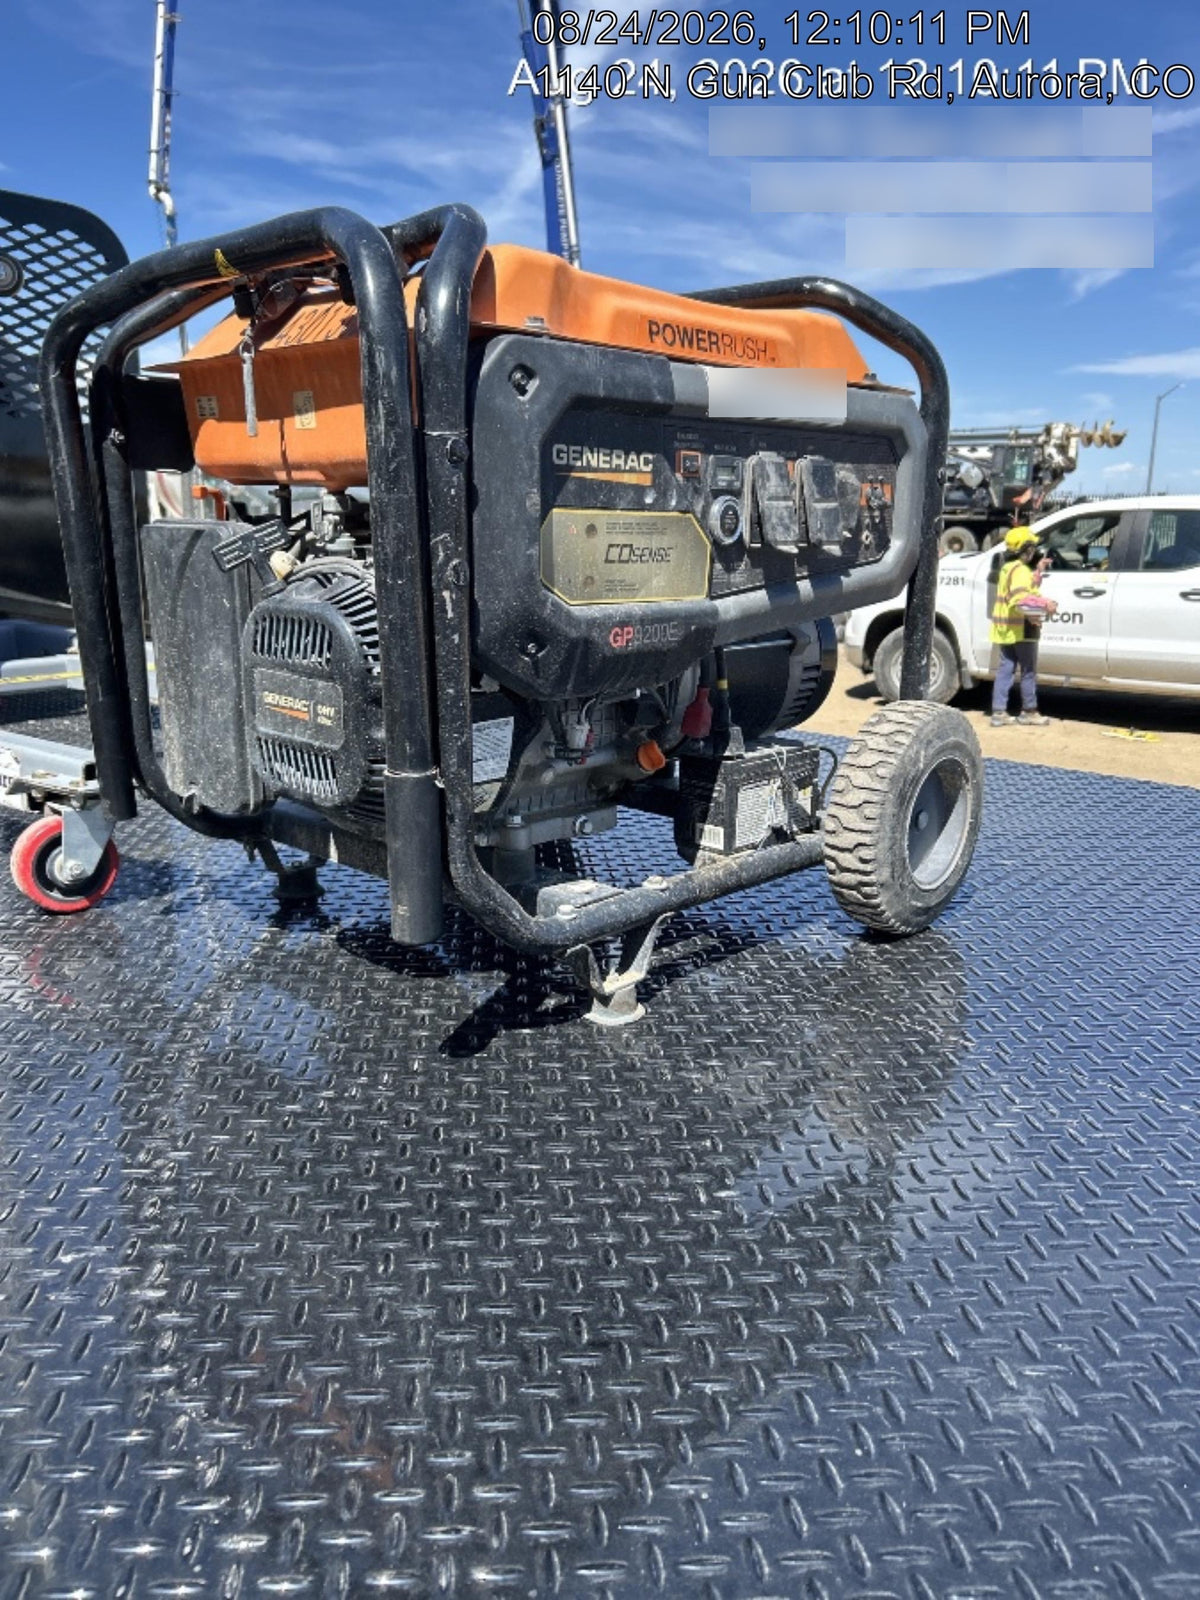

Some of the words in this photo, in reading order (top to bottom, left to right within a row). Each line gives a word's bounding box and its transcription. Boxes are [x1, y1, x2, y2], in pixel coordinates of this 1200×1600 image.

[648, 319, 768, 361] POWERRUSH
[552, 444, 654, 472] GENERAC
[262, 691, 309, 712] GENERAC
